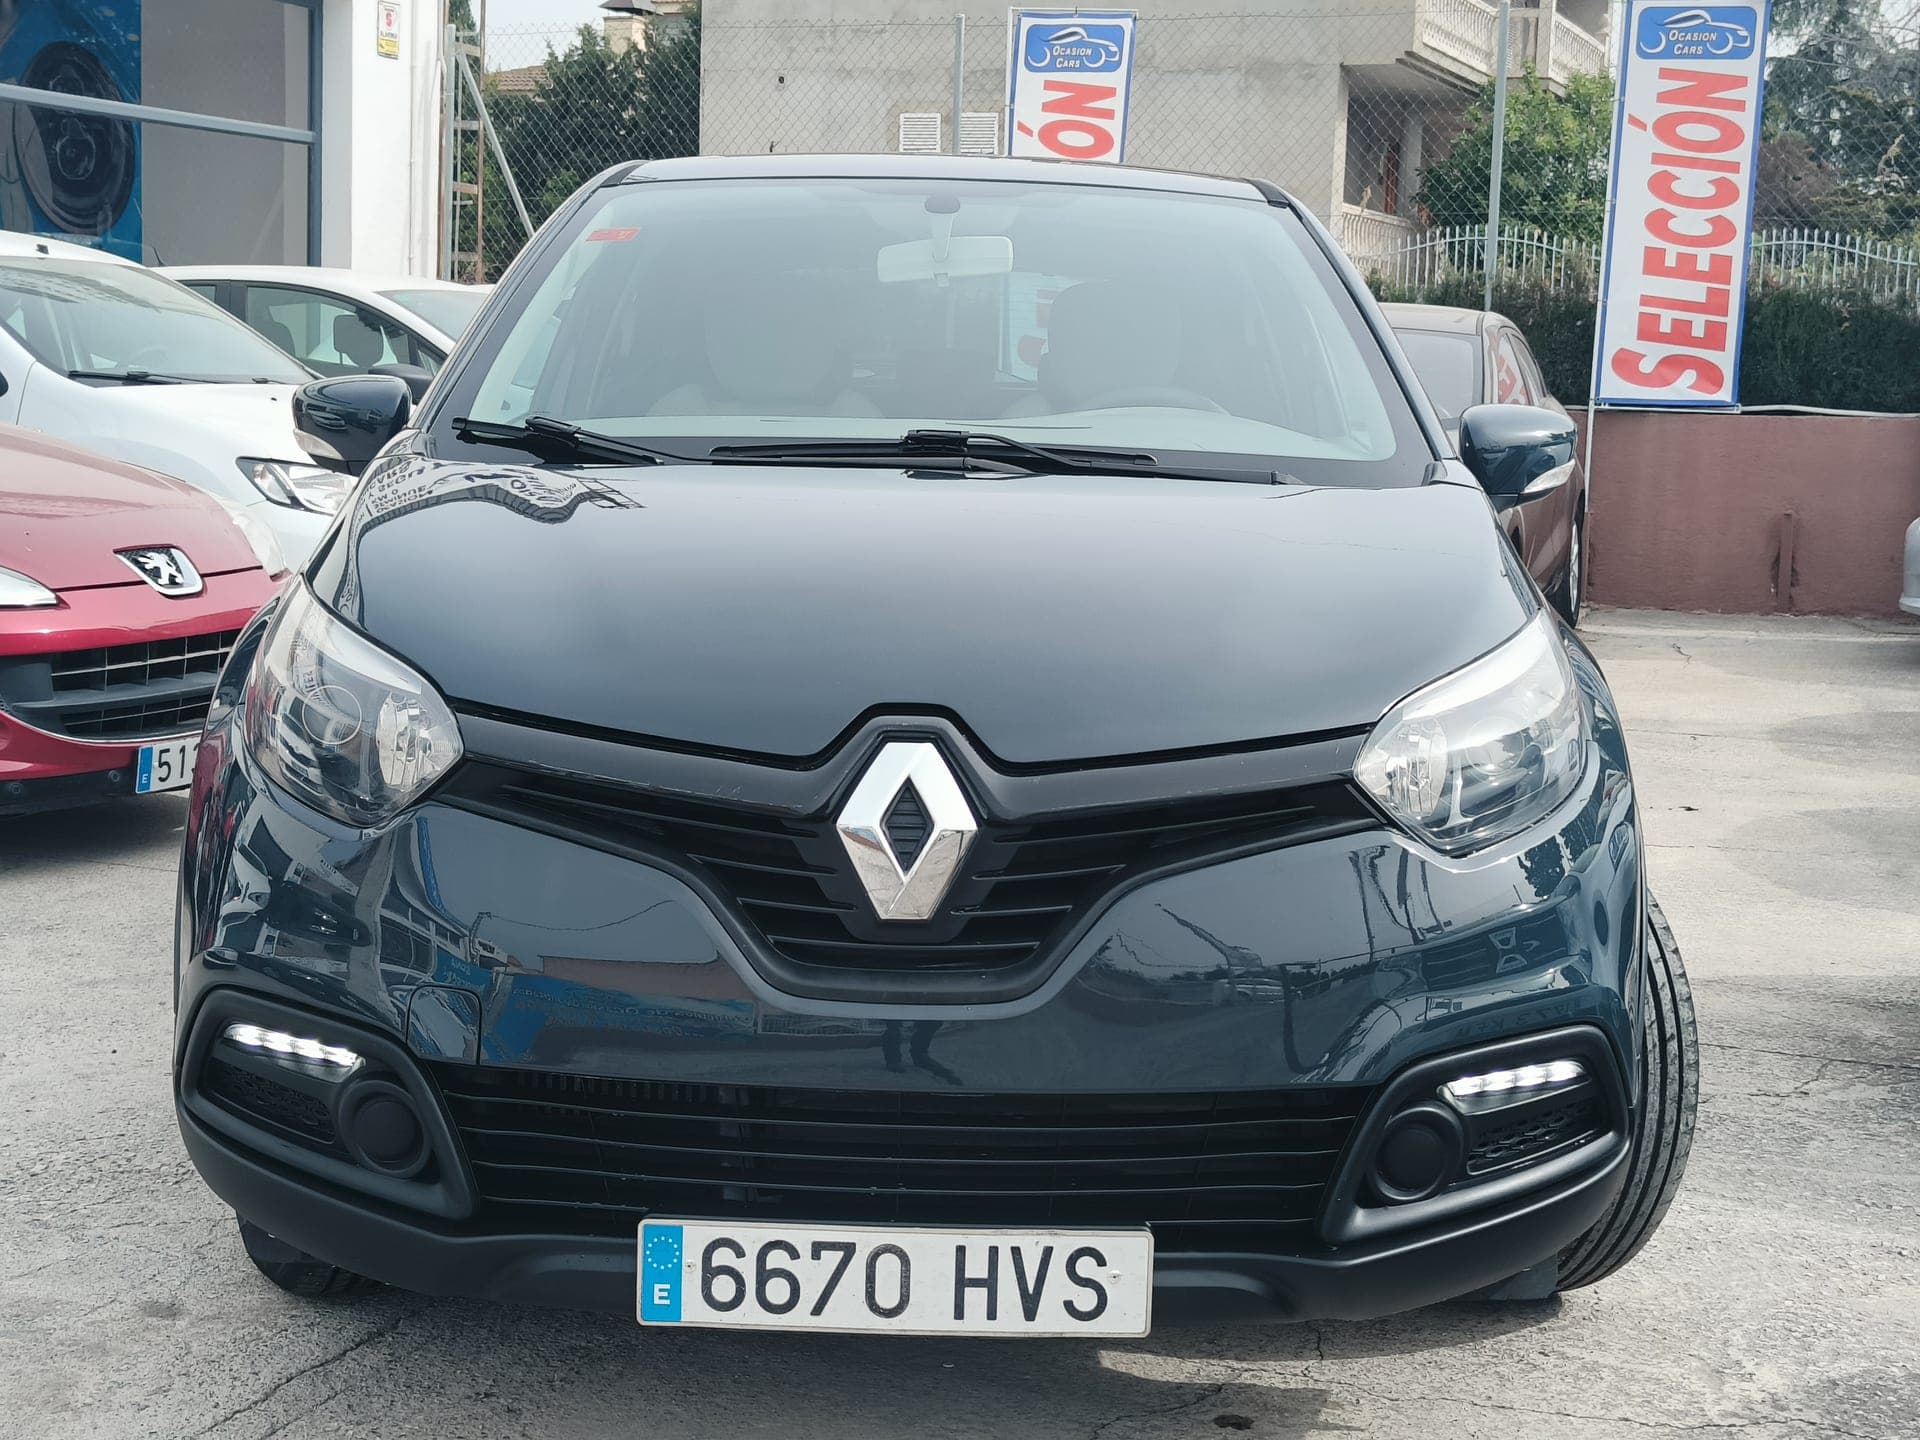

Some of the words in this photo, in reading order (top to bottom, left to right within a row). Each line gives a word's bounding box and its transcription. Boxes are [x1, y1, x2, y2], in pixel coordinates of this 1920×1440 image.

[1669, 30, 1717, 41] OCASION
[1052, 45, 1093, 56] OCASION
[1673, 44, 1704, 55] CARS
[1056, 58, 1081, 68] CARS
[1611, 67, 1748, 396] SELECCIÓN
[142, 773, 149, 784] E
[653, 1283, 671, 1305] E
[700, 1236, 911, 1319] 6670
[953, 1245, 1109, 1322] HVS
